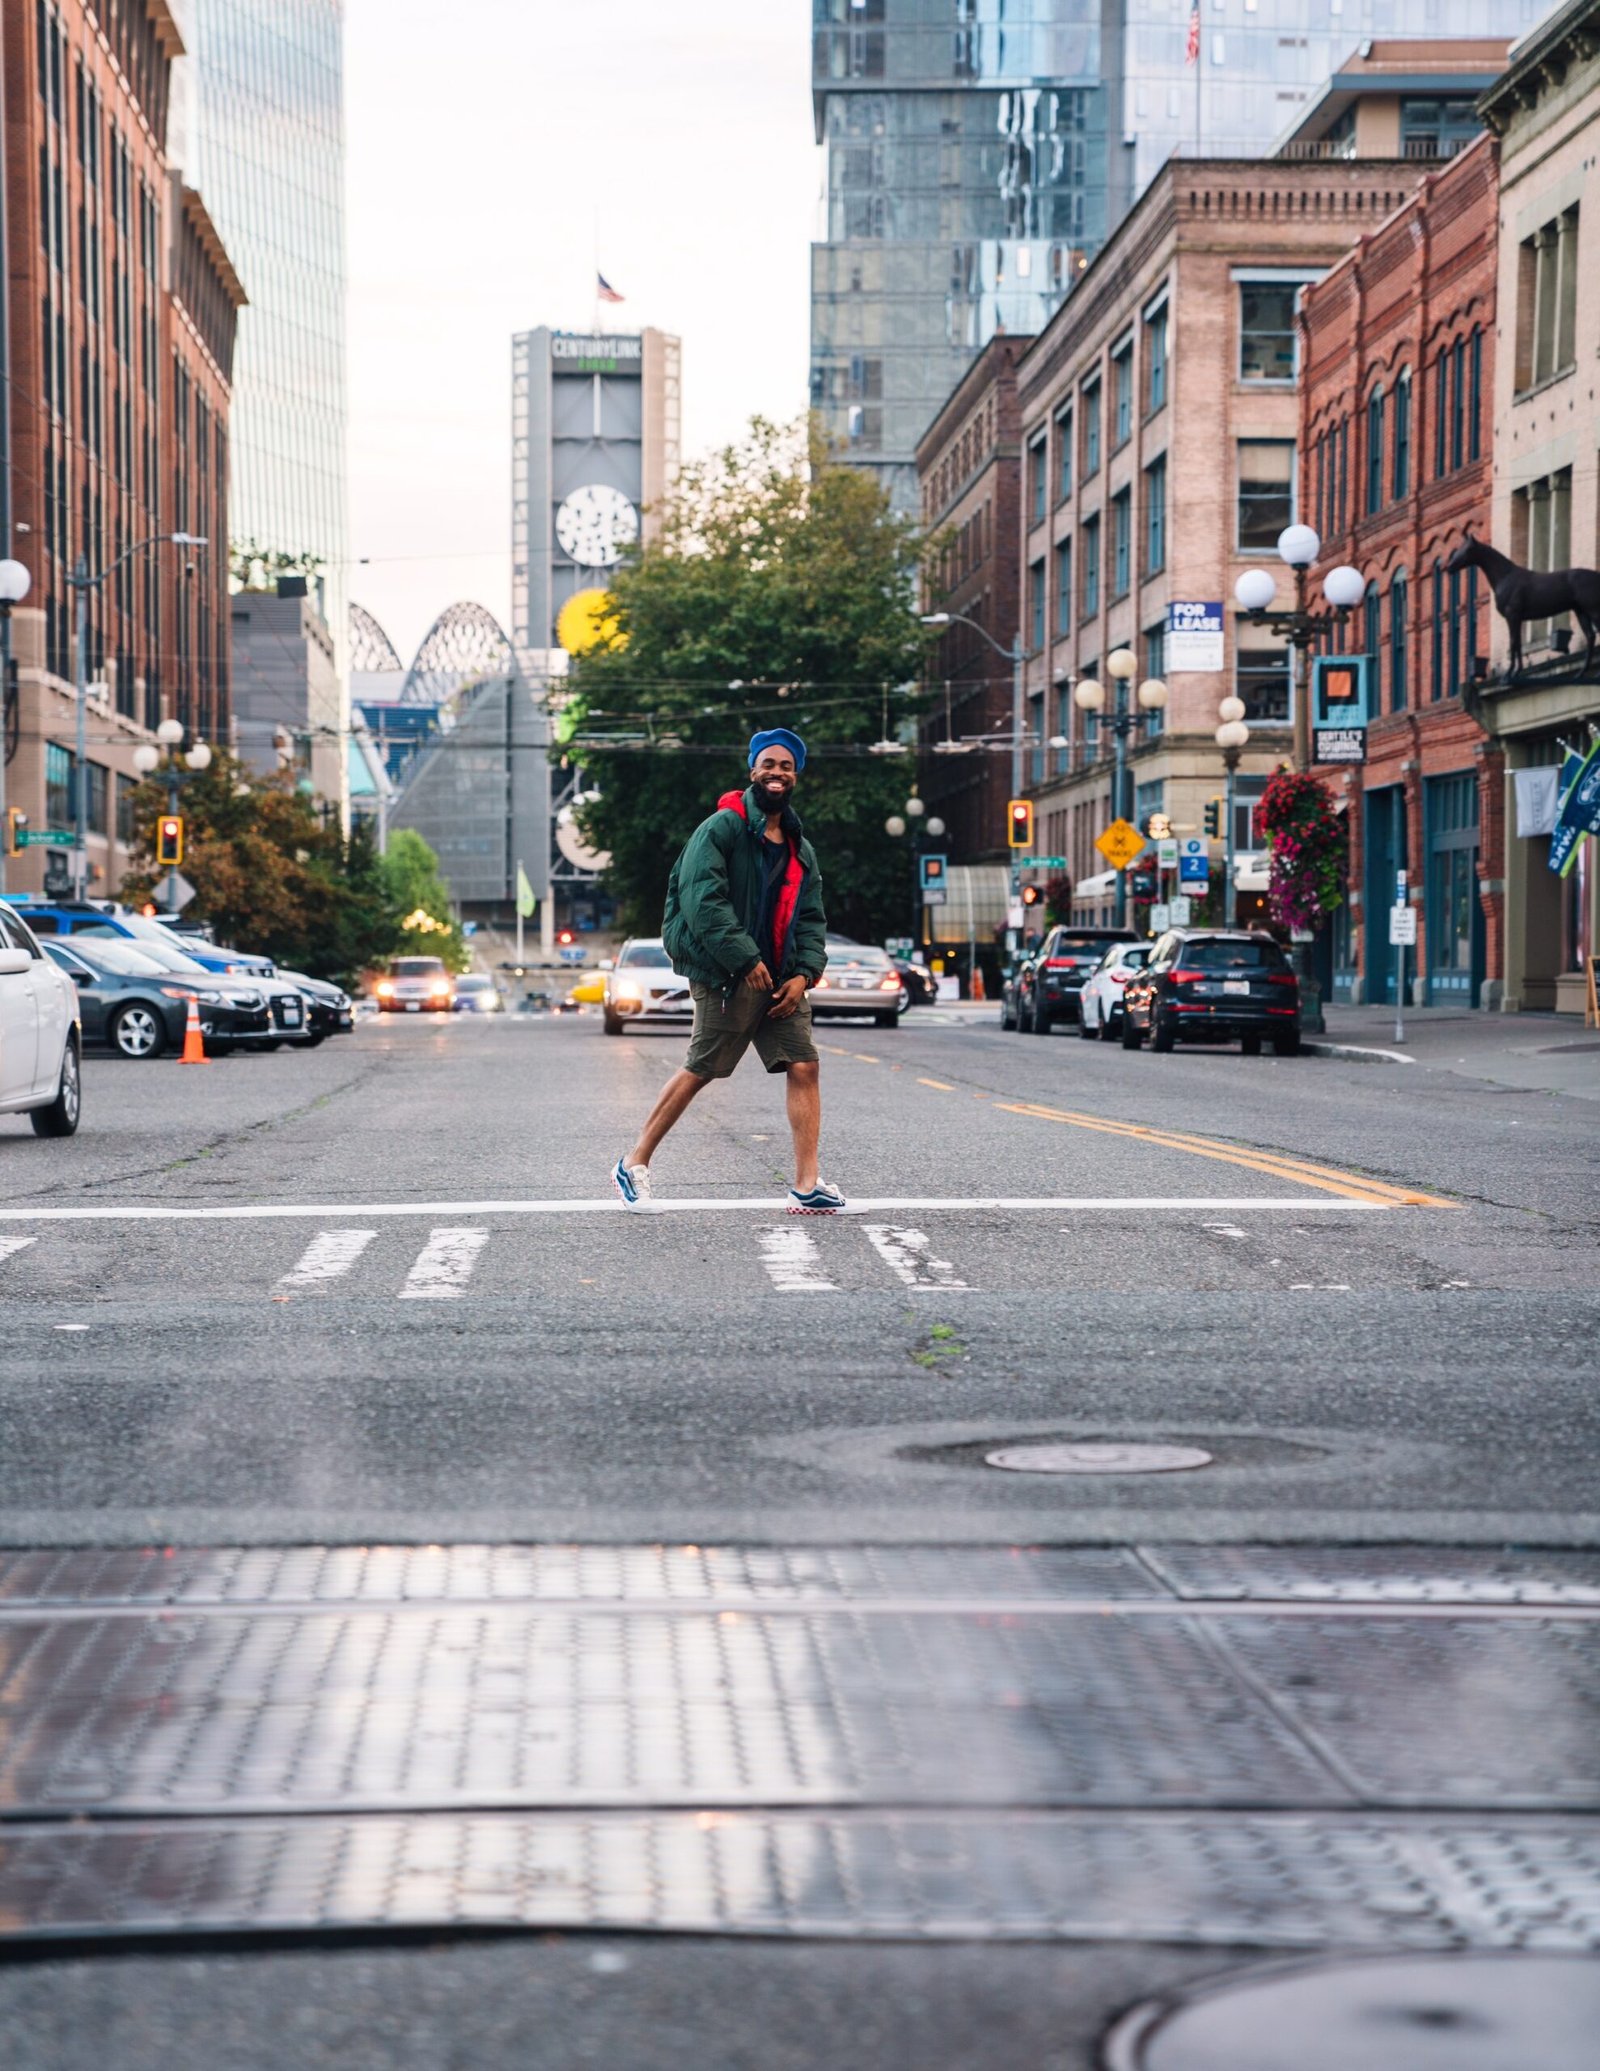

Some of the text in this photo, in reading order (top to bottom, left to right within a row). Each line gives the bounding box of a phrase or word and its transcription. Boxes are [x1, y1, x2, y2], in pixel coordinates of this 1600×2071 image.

[1174, 603, 1206, 617] FOR
[1173, 617, 1221, 631] LEASE
[1189, 858, 1199, 871] 2
